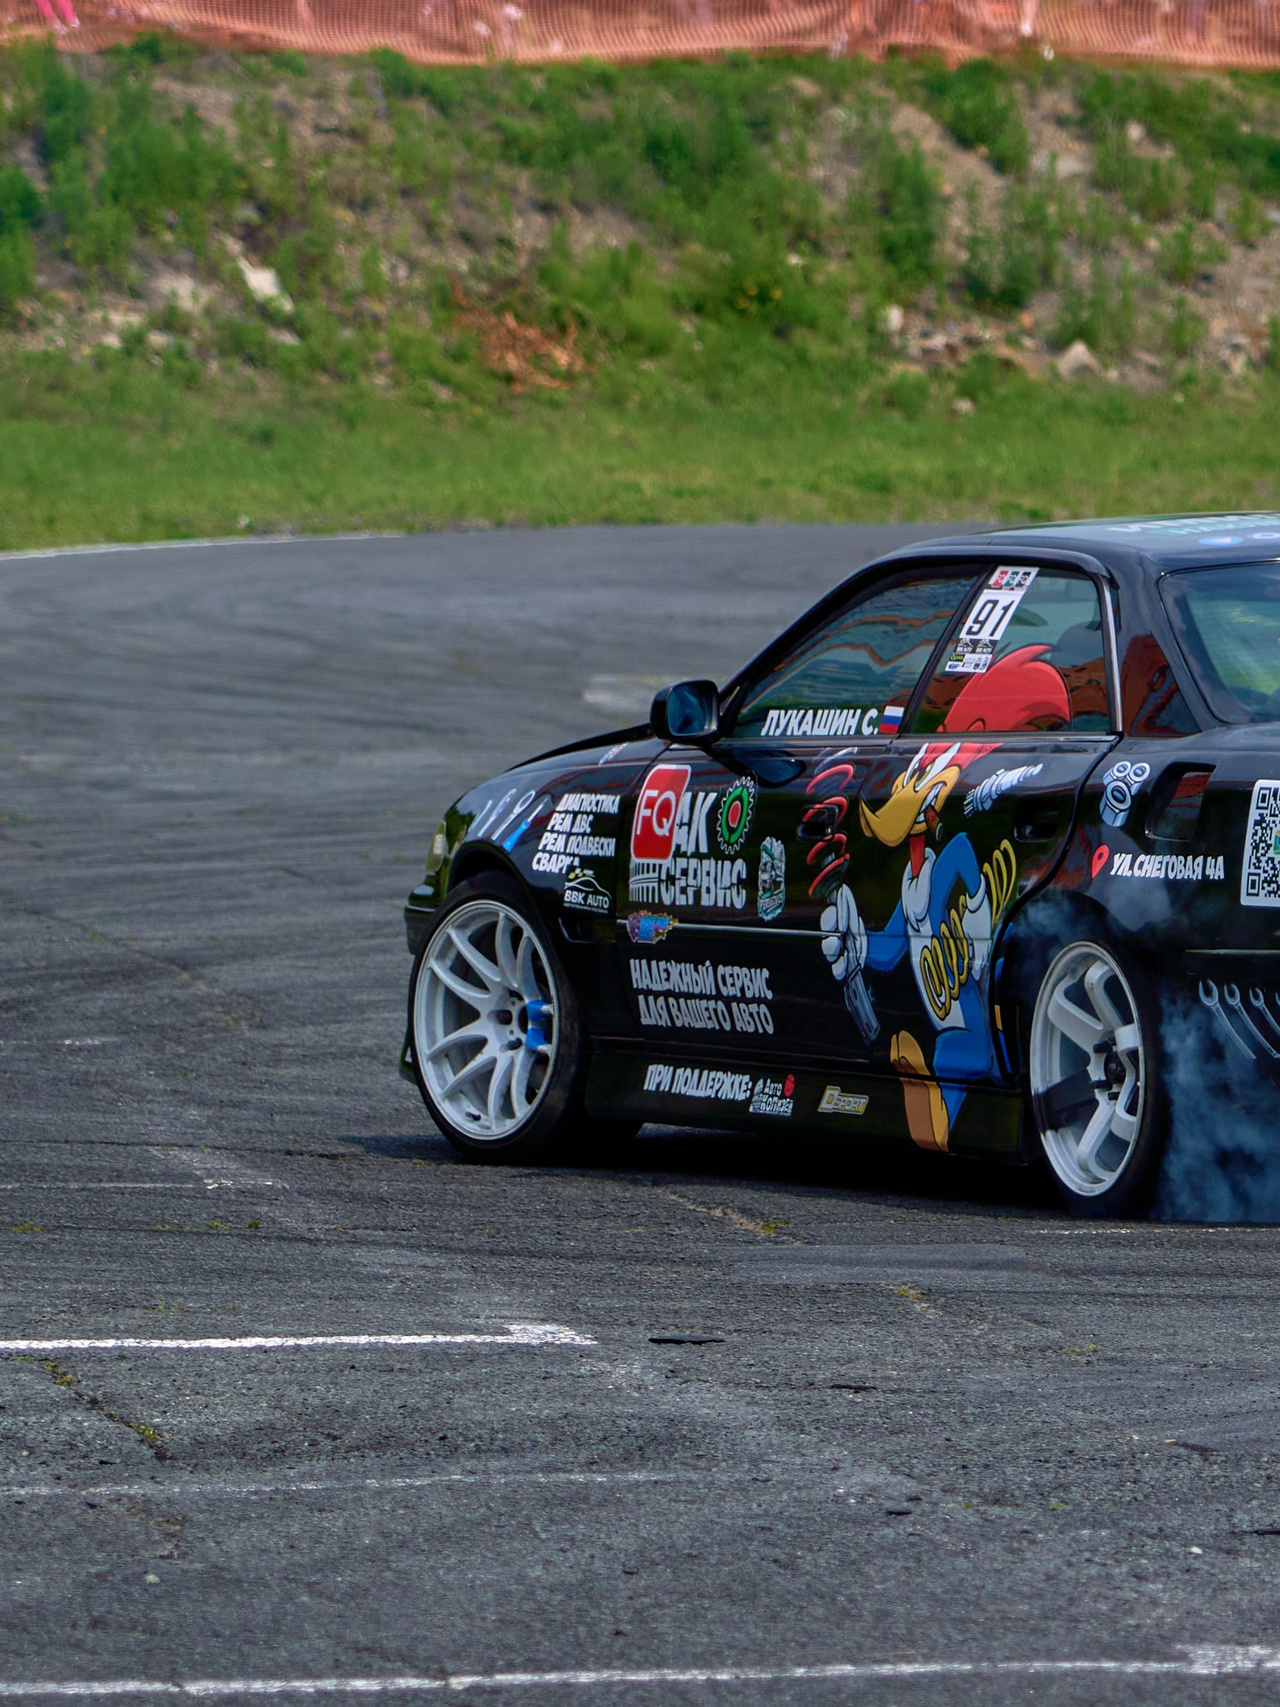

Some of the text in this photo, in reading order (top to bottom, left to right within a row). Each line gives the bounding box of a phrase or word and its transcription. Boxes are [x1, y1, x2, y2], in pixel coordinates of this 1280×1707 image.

[965, 599, 1016, 637] 91
[760, 707, 879, 737] ЛУКАШИН С.
[555, 793, 620, 814] ДИАГНОСТИКА
[636, 789, 677, 837] FQ
[546, 812, 594, 833] РЕМ ДВС
[538, 831, 617, 857] РЕМ ПОДВЕСКИ
[660, 857, 747, 910] СЕРВИС
[1205, 855, 1225, 880] 4А
[586, 895, 610, 909] AUTO
[629, 959, 773, 1000] НАДЕЖНЫЙ СЕРВИС
[638, 994, 775, 1035] ДЛЯ ВАШЕГО АВТО
[643, 1064, 752, 1101] ПРИ ПОДДЕРЖКЕ:
